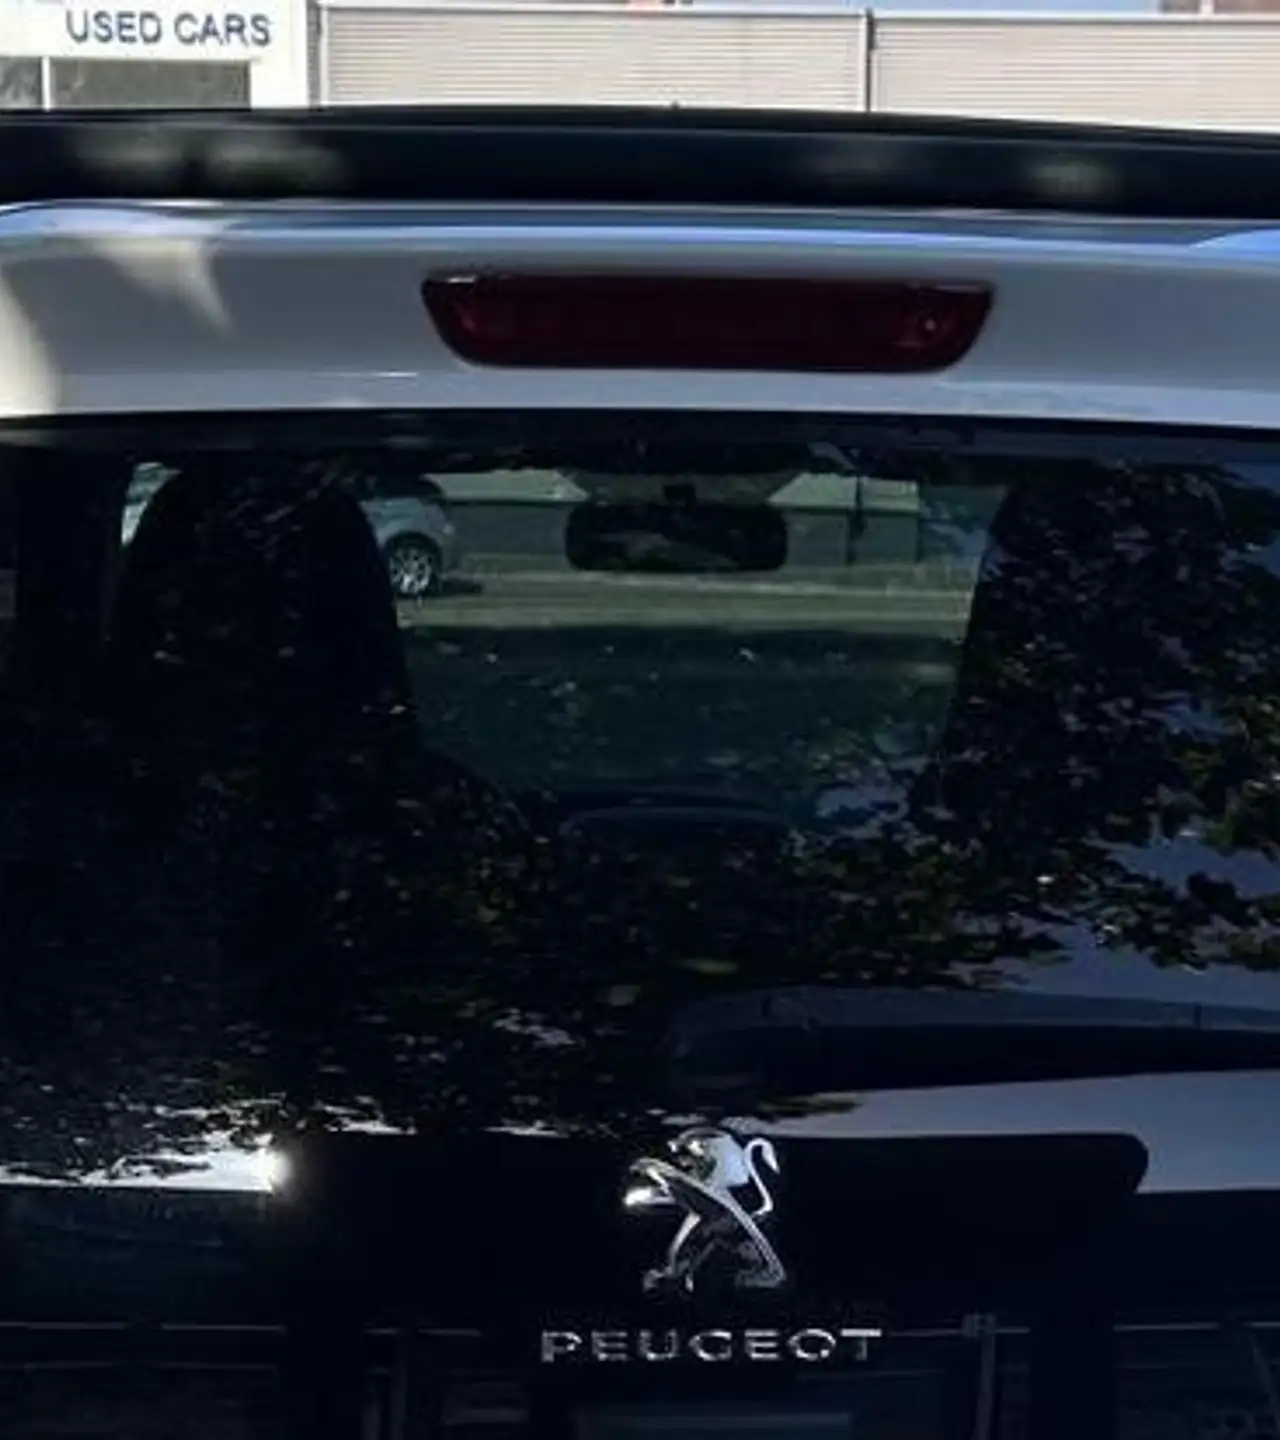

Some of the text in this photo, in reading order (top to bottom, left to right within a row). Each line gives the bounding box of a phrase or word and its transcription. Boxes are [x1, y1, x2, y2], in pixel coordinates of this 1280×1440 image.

[66, 10, 272, 47] USED CARS
[540, 1328, 883, 1363] PEUGEOT
